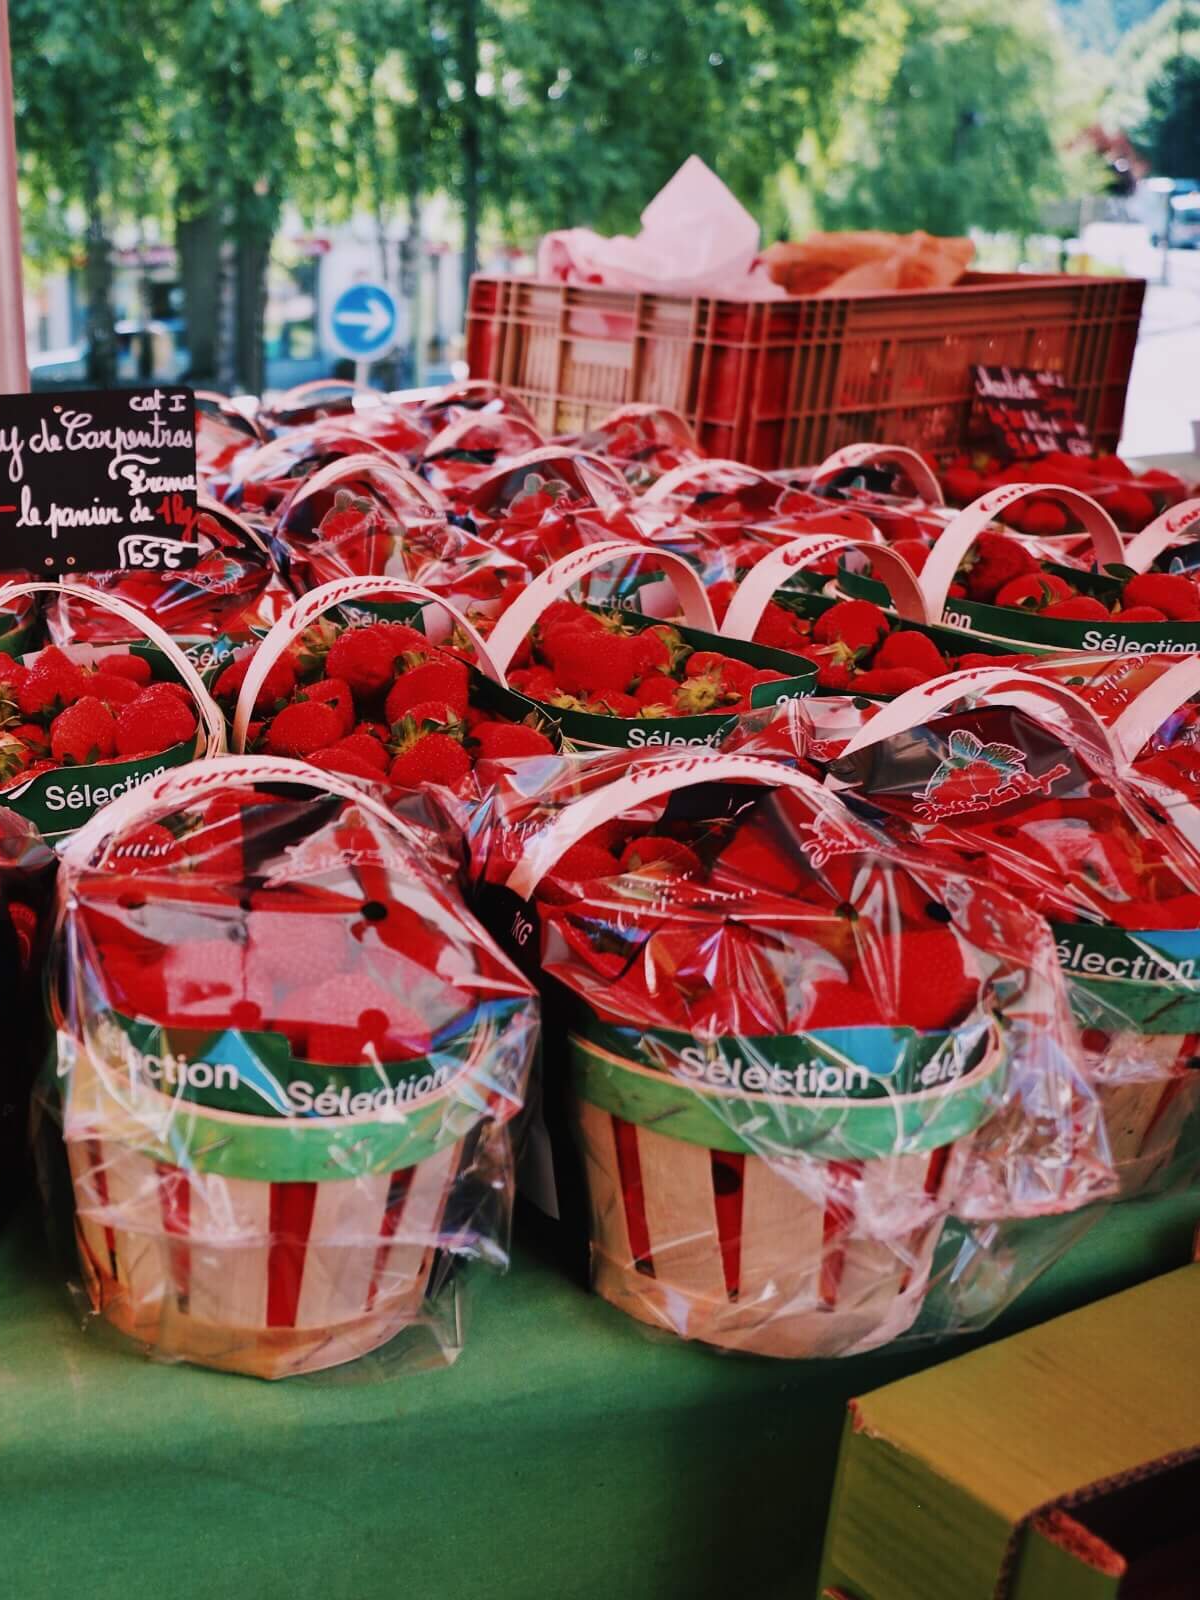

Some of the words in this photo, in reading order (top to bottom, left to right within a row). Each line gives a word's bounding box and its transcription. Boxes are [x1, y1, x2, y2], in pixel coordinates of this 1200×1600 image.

[29, 418, 63, 453] de
[60, 410, 194, 458] Carpentras
[15, 484, 42, 528] le
[44, 497, 124, 539] panier
[129, 498, 155, 524] de
[626, 726, 724, 750] Sélecti
[1055, 939, 1196, 980] élection
